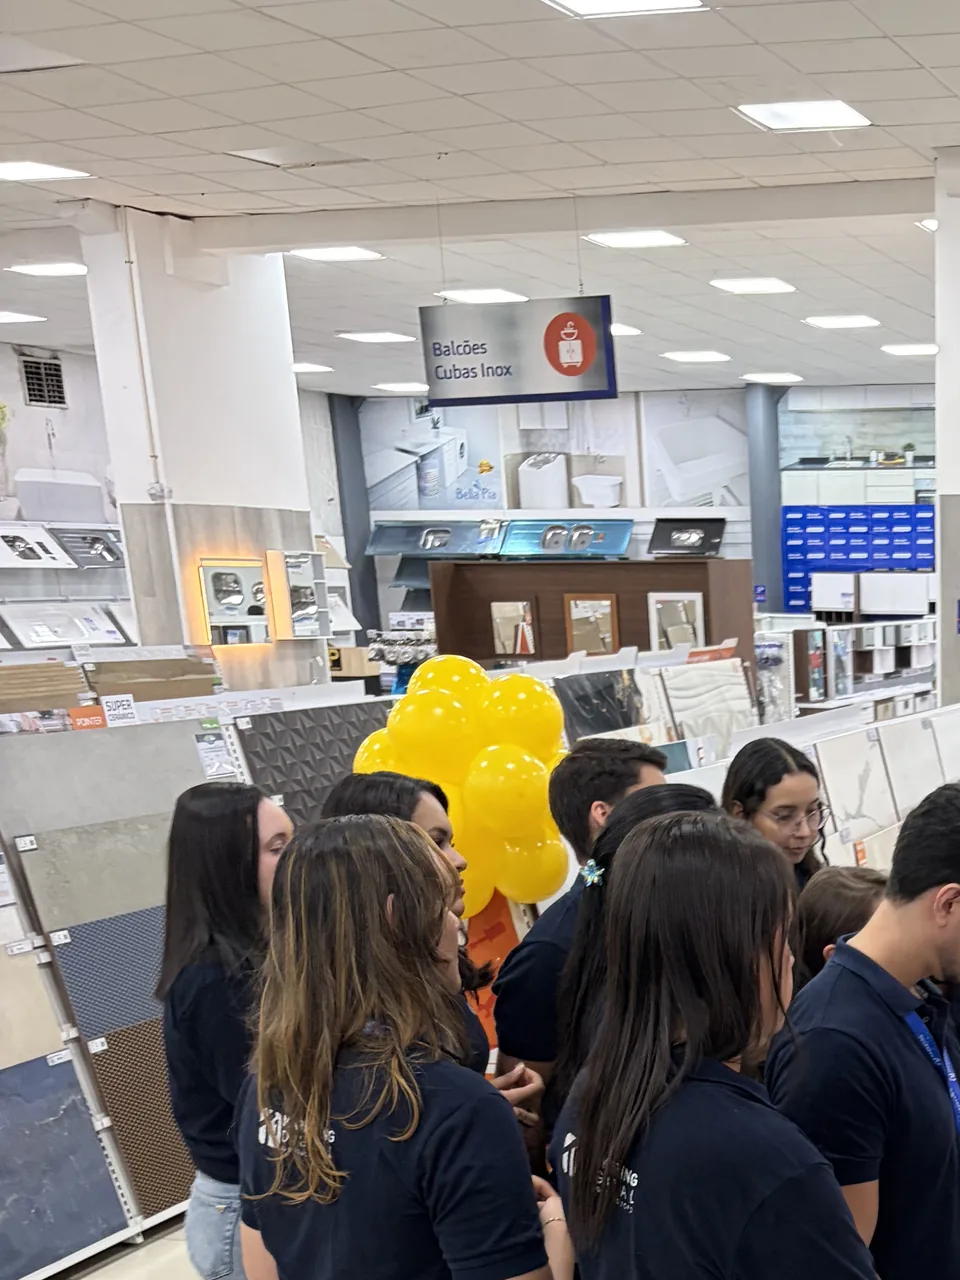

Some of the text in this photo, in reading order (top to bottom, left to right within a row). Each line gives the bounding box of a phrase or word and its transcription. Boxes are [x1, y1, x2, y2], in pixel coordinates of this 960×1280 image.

[432, 340, 488, 357] Balcões
[434, 362, 513, 380] Cubas Inox
[105, 699, 132, 711] SUPER
